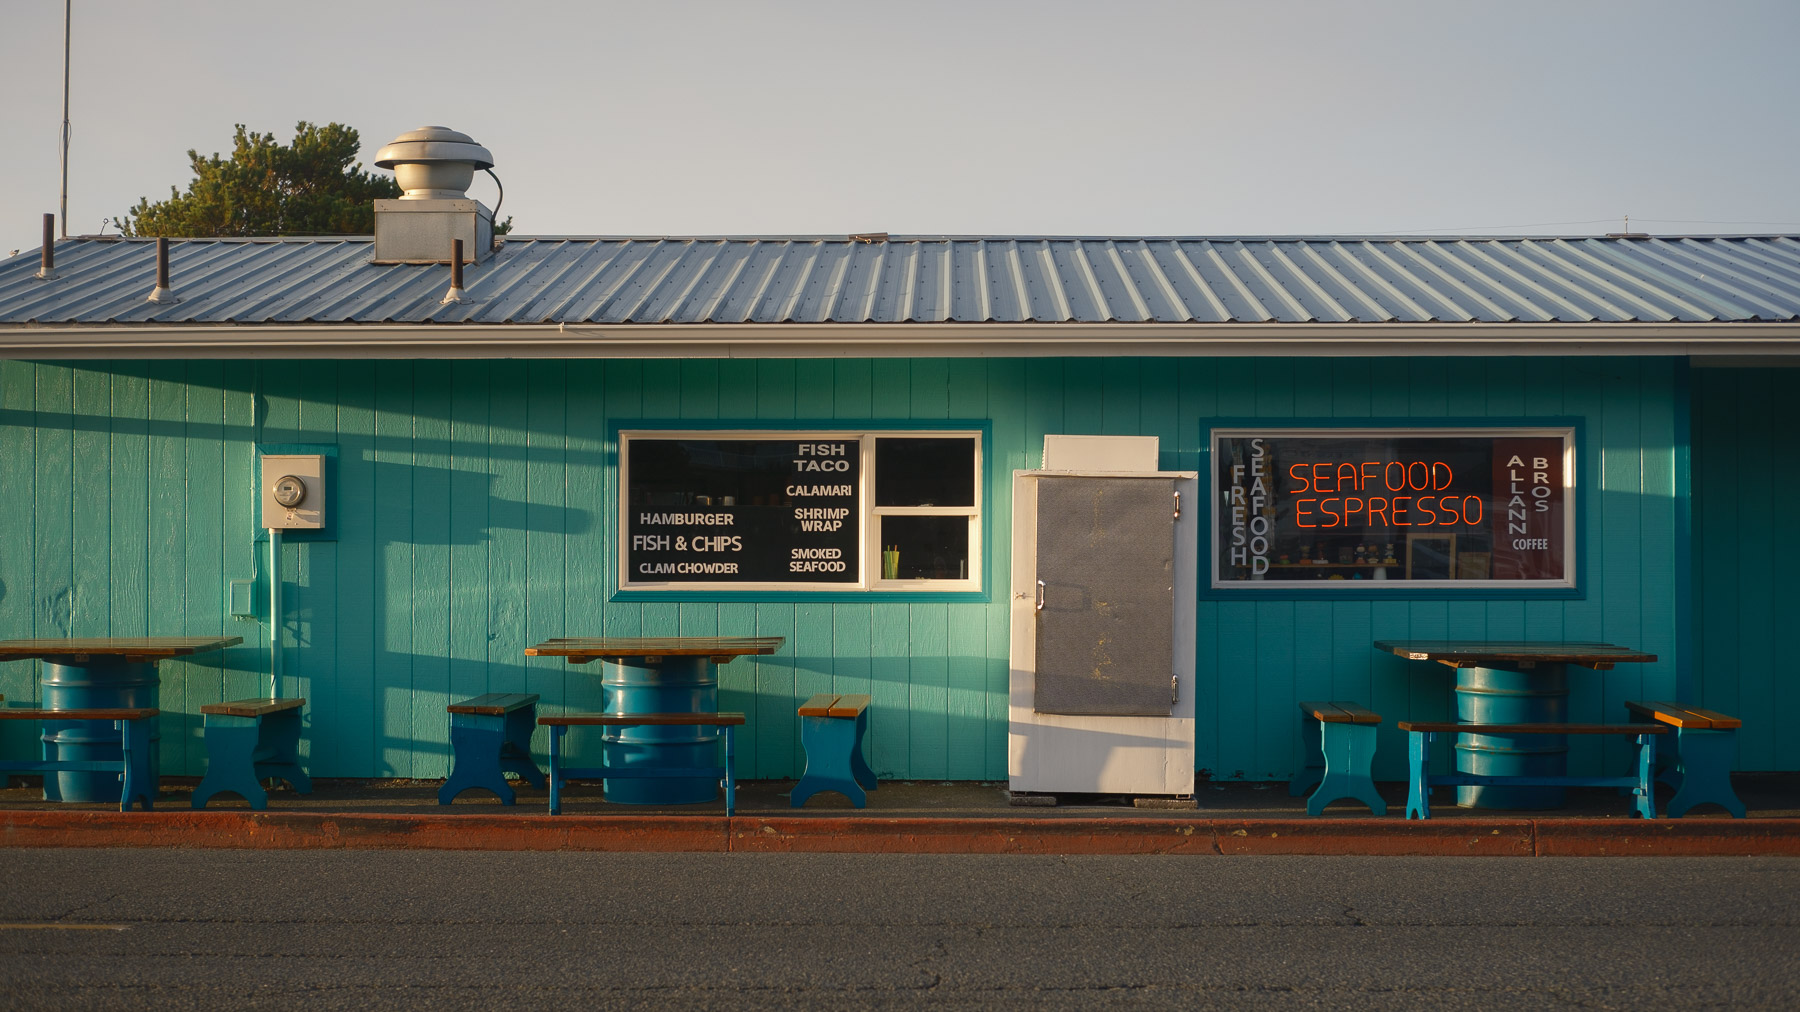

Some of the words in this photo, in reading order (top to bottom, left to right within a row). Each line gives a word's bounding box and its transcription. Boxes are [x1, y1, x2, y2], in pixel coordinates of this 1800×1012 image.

[799, 443, 845, 456] FISH
[793, 460, 849, 472] TACO
[1289, 461, 1453, 493] SEAFOOD
[786, 485, 852, 497] CALAMARI
[1531, 457, 1552, 512] BROS
[1507, 455, 1527, 535] ALLANN
[1250, 438, 1269, 575] SEAFOOD
[1295, 495, 1483, 527] ESPRESSO
[640, 513, 734, 526] HAMBURGER
[794, 508, 849, 520] SHRIMP
[1231, 464, 1247, 566] FRESH
[801, 520, 842, 532] WRAP
[633, 535, 670, 551] FISH
[675, 535, 688, 551] &
[691, 536, 742, 552] CHIPS
[1512, 538, 1548, 550] COFFEE
[791, 548, 842, 560] SMOKED
[639, 563, 676, 574] CLAM
[677, 562, 738, 574] CHOWDER
[789, 561, 846, 573] SEAFOOD
